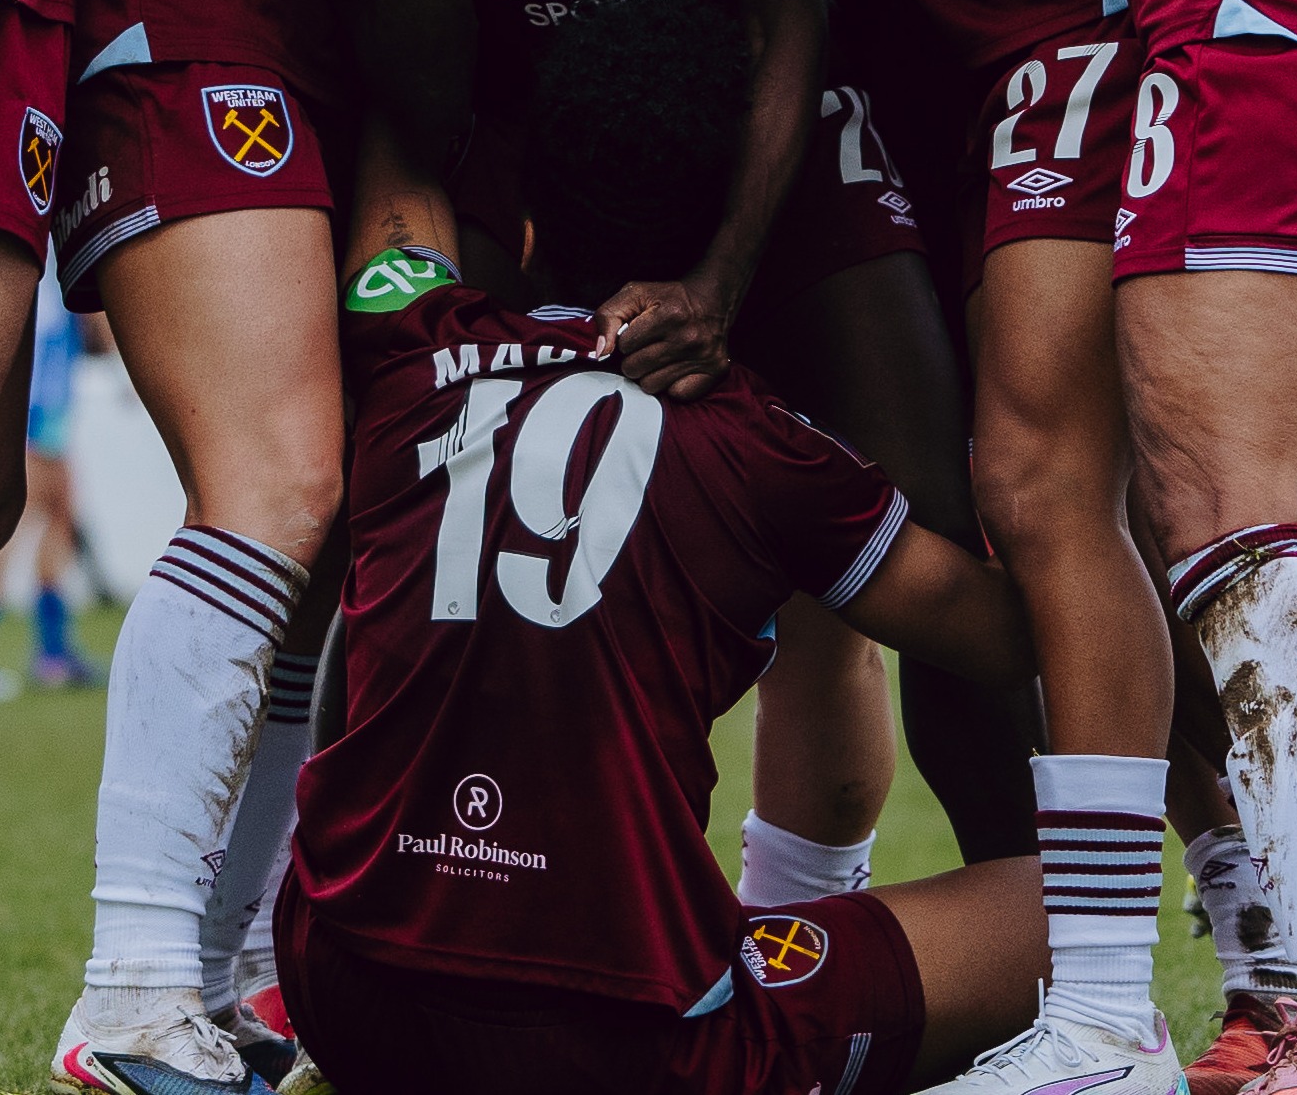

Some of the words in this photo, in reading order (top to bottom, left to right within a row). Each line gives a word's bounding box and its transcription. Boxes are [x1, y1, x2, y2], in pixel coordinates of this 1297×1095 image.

[211, 89, 245, 103] WEST
[246, 89, 277, 103] HAM
[227, 98, 266, 108] UNITED
[991, 42, 1119, 170] 27
[1012, 195, 1066, 212] umbro
[418, 371, 663, 628] 19
[396, 833, 447, 855] Paul
[448, 836, 547, 870] Robinson
[435, 863, 510, 883] SOLICITORS
